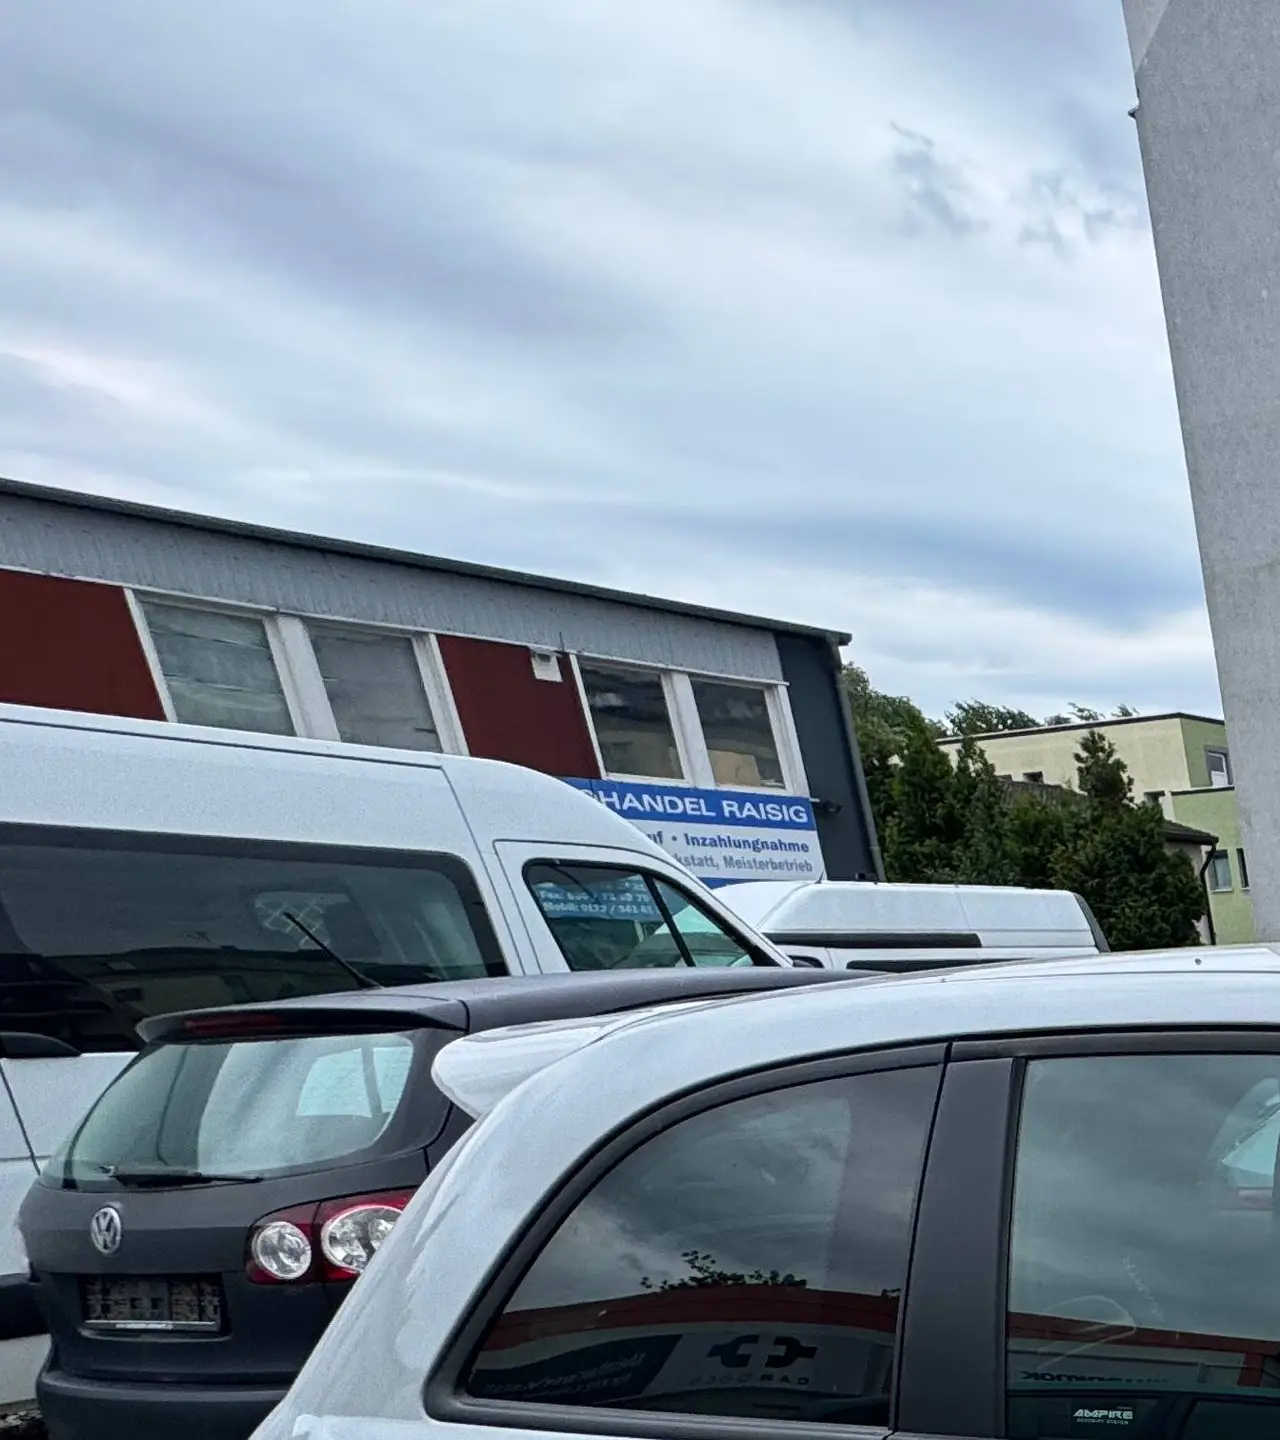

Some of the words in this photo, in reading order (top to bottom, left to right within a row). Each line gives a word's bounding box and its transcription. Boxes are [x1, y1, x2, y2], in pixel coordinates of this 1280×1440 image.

[580, 789, 716, 817] HANDEL
[721, 800, 808, 823] RAISIG
[684, 833, 810, 853] Inzahlungnahme
[674, 853, 720, 870] kstatt,
[723, 855, 813, 872] Meisterbetrieb
[1073, 1409, 1133, 1420] AMPIRE
